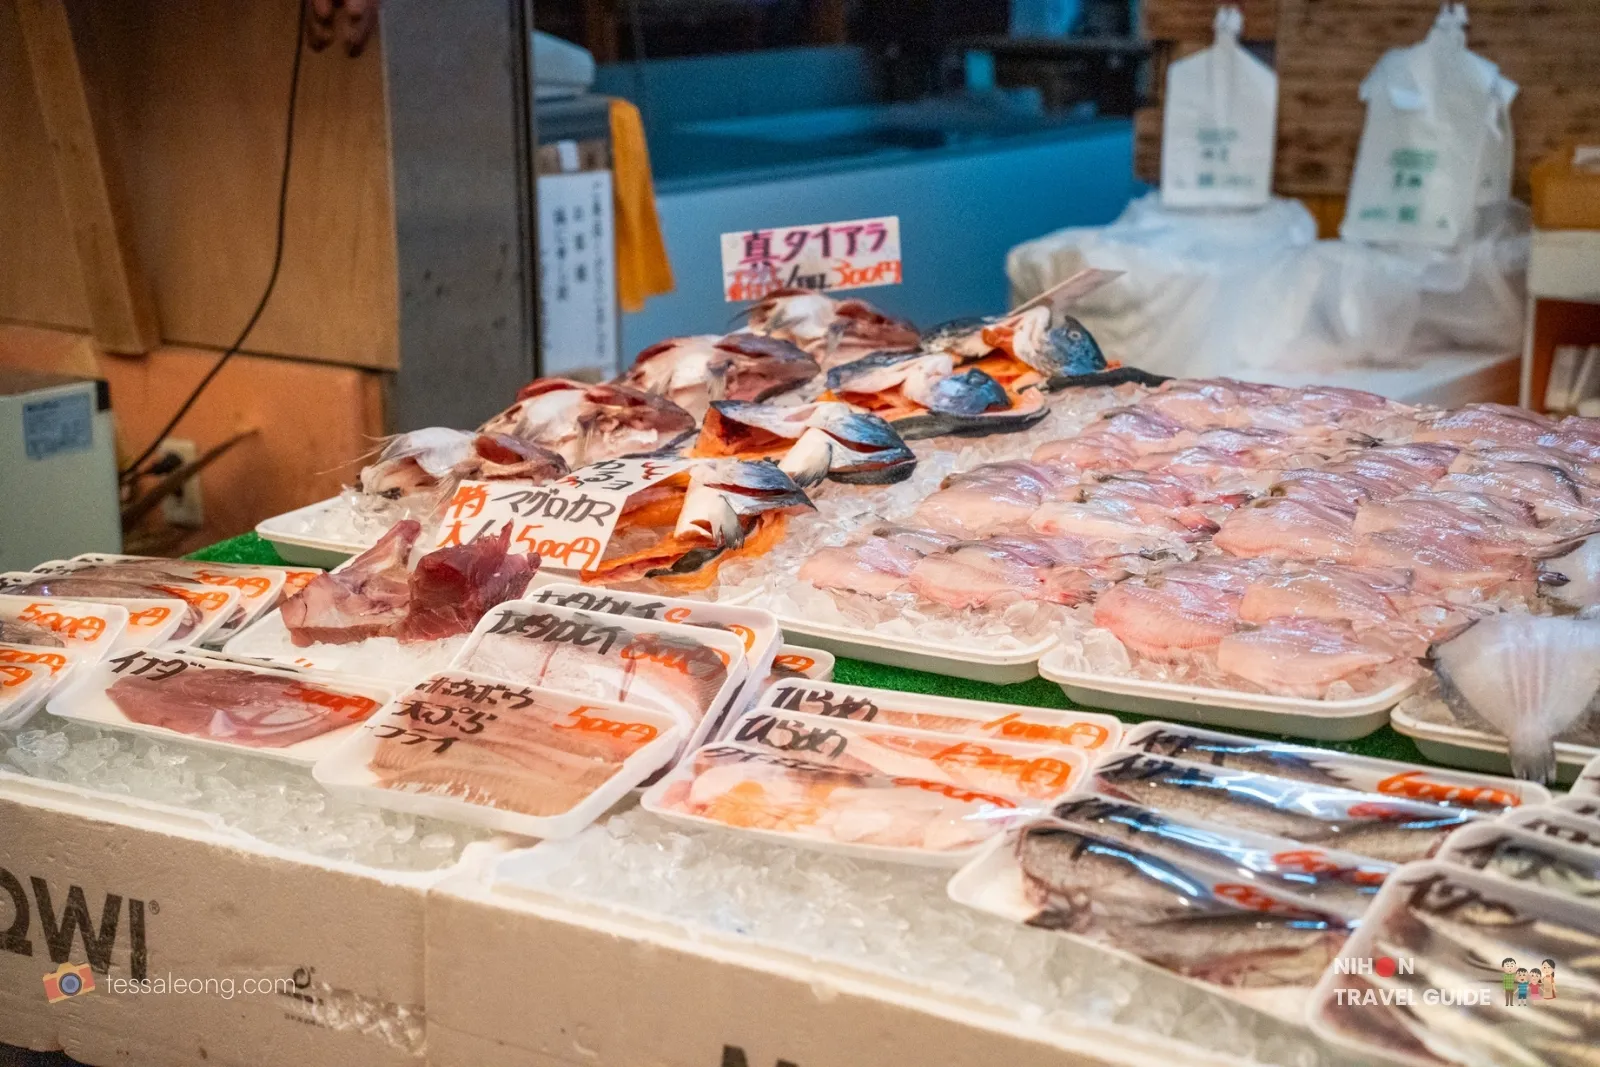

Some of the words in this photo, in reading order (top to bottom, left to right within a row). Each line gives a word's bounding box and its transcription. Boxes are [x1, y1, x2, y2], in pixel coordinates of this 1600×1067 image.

[515, 524, 601, 571] 500円
[16, 603, 107, 642] 500円
[109, 650, 206, 681] イナダ
[374, 724, 460, 753] フライ
[553, 705, 658, 743] 500円
